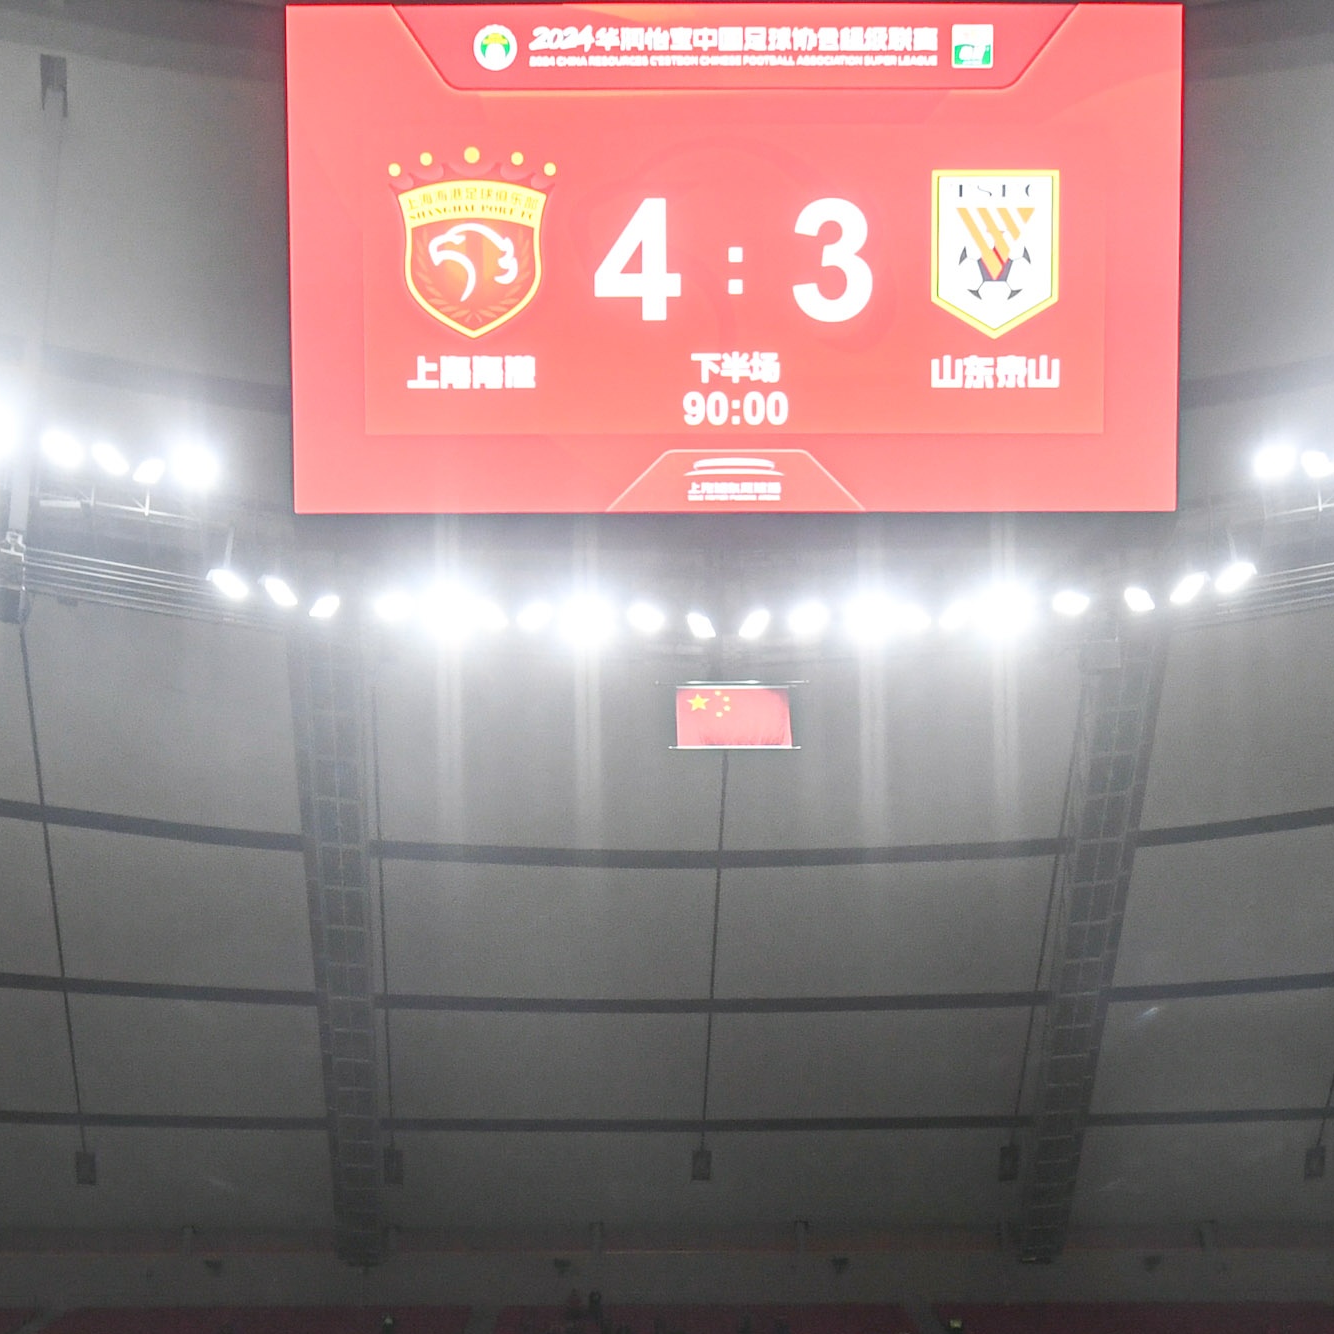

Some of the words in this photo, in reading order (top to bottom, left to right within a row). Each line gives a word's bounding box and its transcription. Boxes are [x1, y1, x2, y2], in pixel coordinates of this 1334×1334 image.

[594, 197, 680, 322] 4
[793, 197, 873, 323] 3
[691, 352, 780, 383] 下半场
[931, 355, 1060, 388] 山东泰山
[683, 391, 788, 425] 90:00
